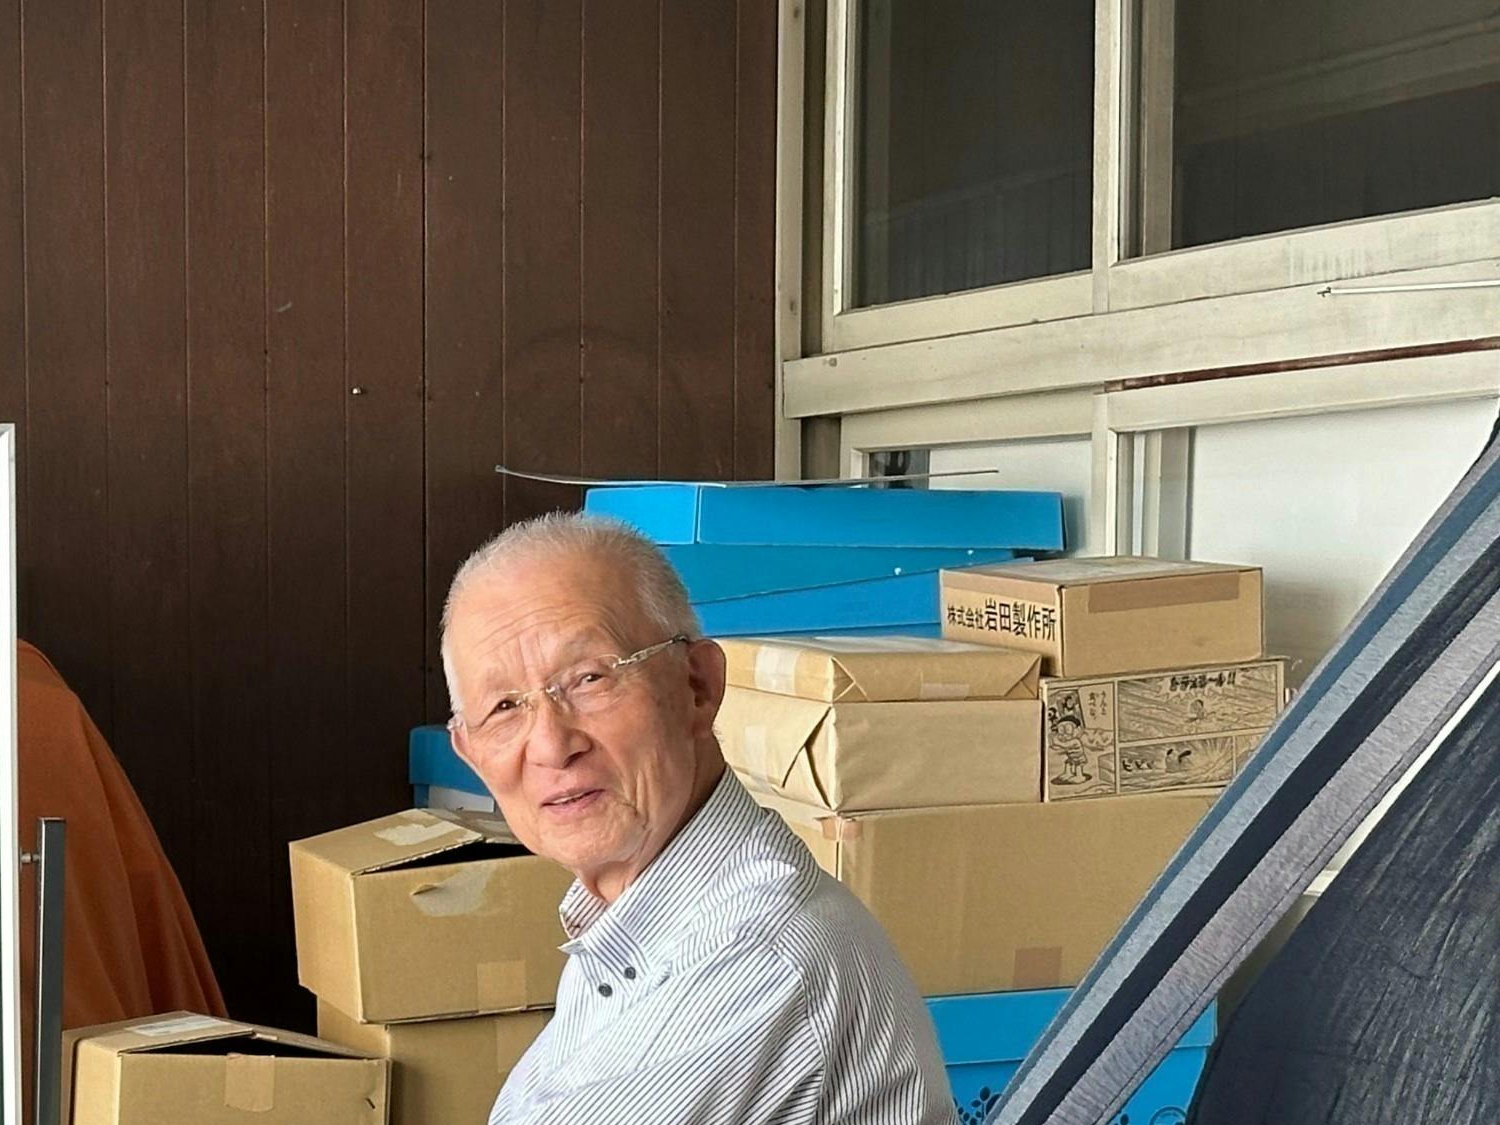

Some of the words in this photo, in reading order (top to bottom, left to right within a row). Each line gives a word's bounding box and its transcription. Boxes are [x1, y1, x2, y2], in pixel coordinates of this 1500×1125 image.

[947, 597, 1057, 642] 株式会社岩田製作所
